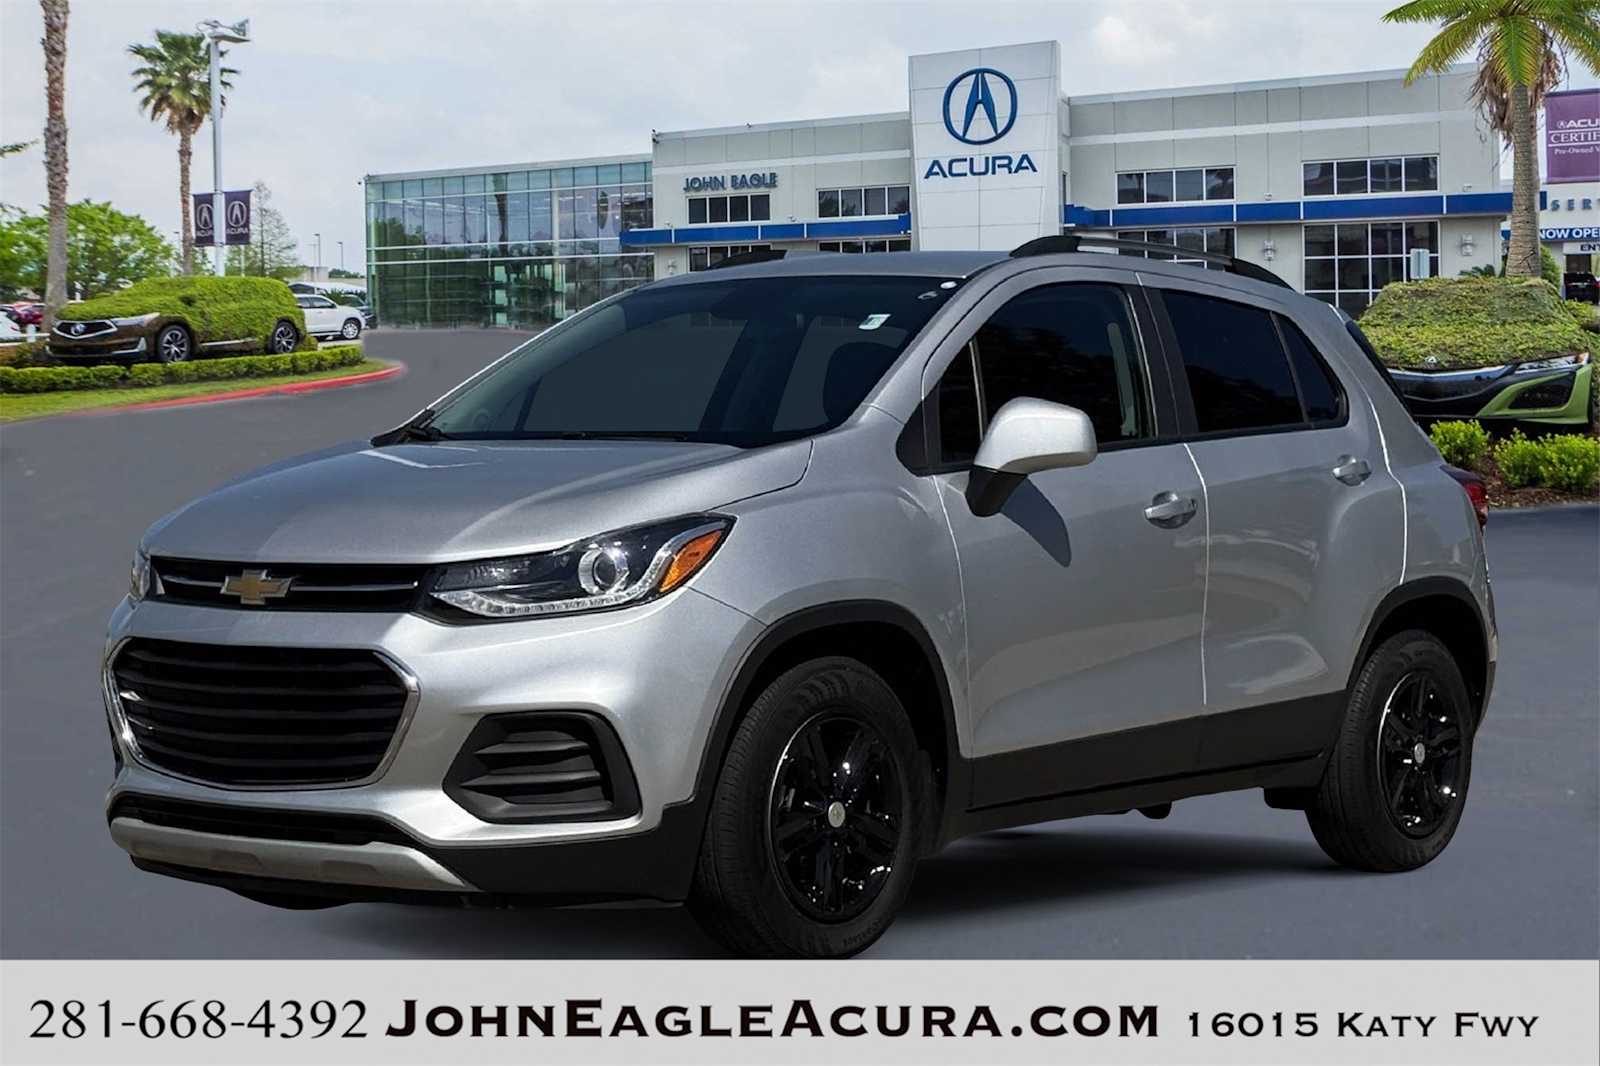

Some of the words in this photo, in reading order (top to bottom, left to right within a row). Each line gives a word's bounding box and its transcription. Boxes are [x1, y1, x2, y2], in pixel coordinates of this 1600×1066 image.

[924, 154, 1038, 180] ACURA
[683, 176, 725, 191] JOHN
[731, 172, 777, 189] EAGLE
[1551, 198, 1600, 211] SER
